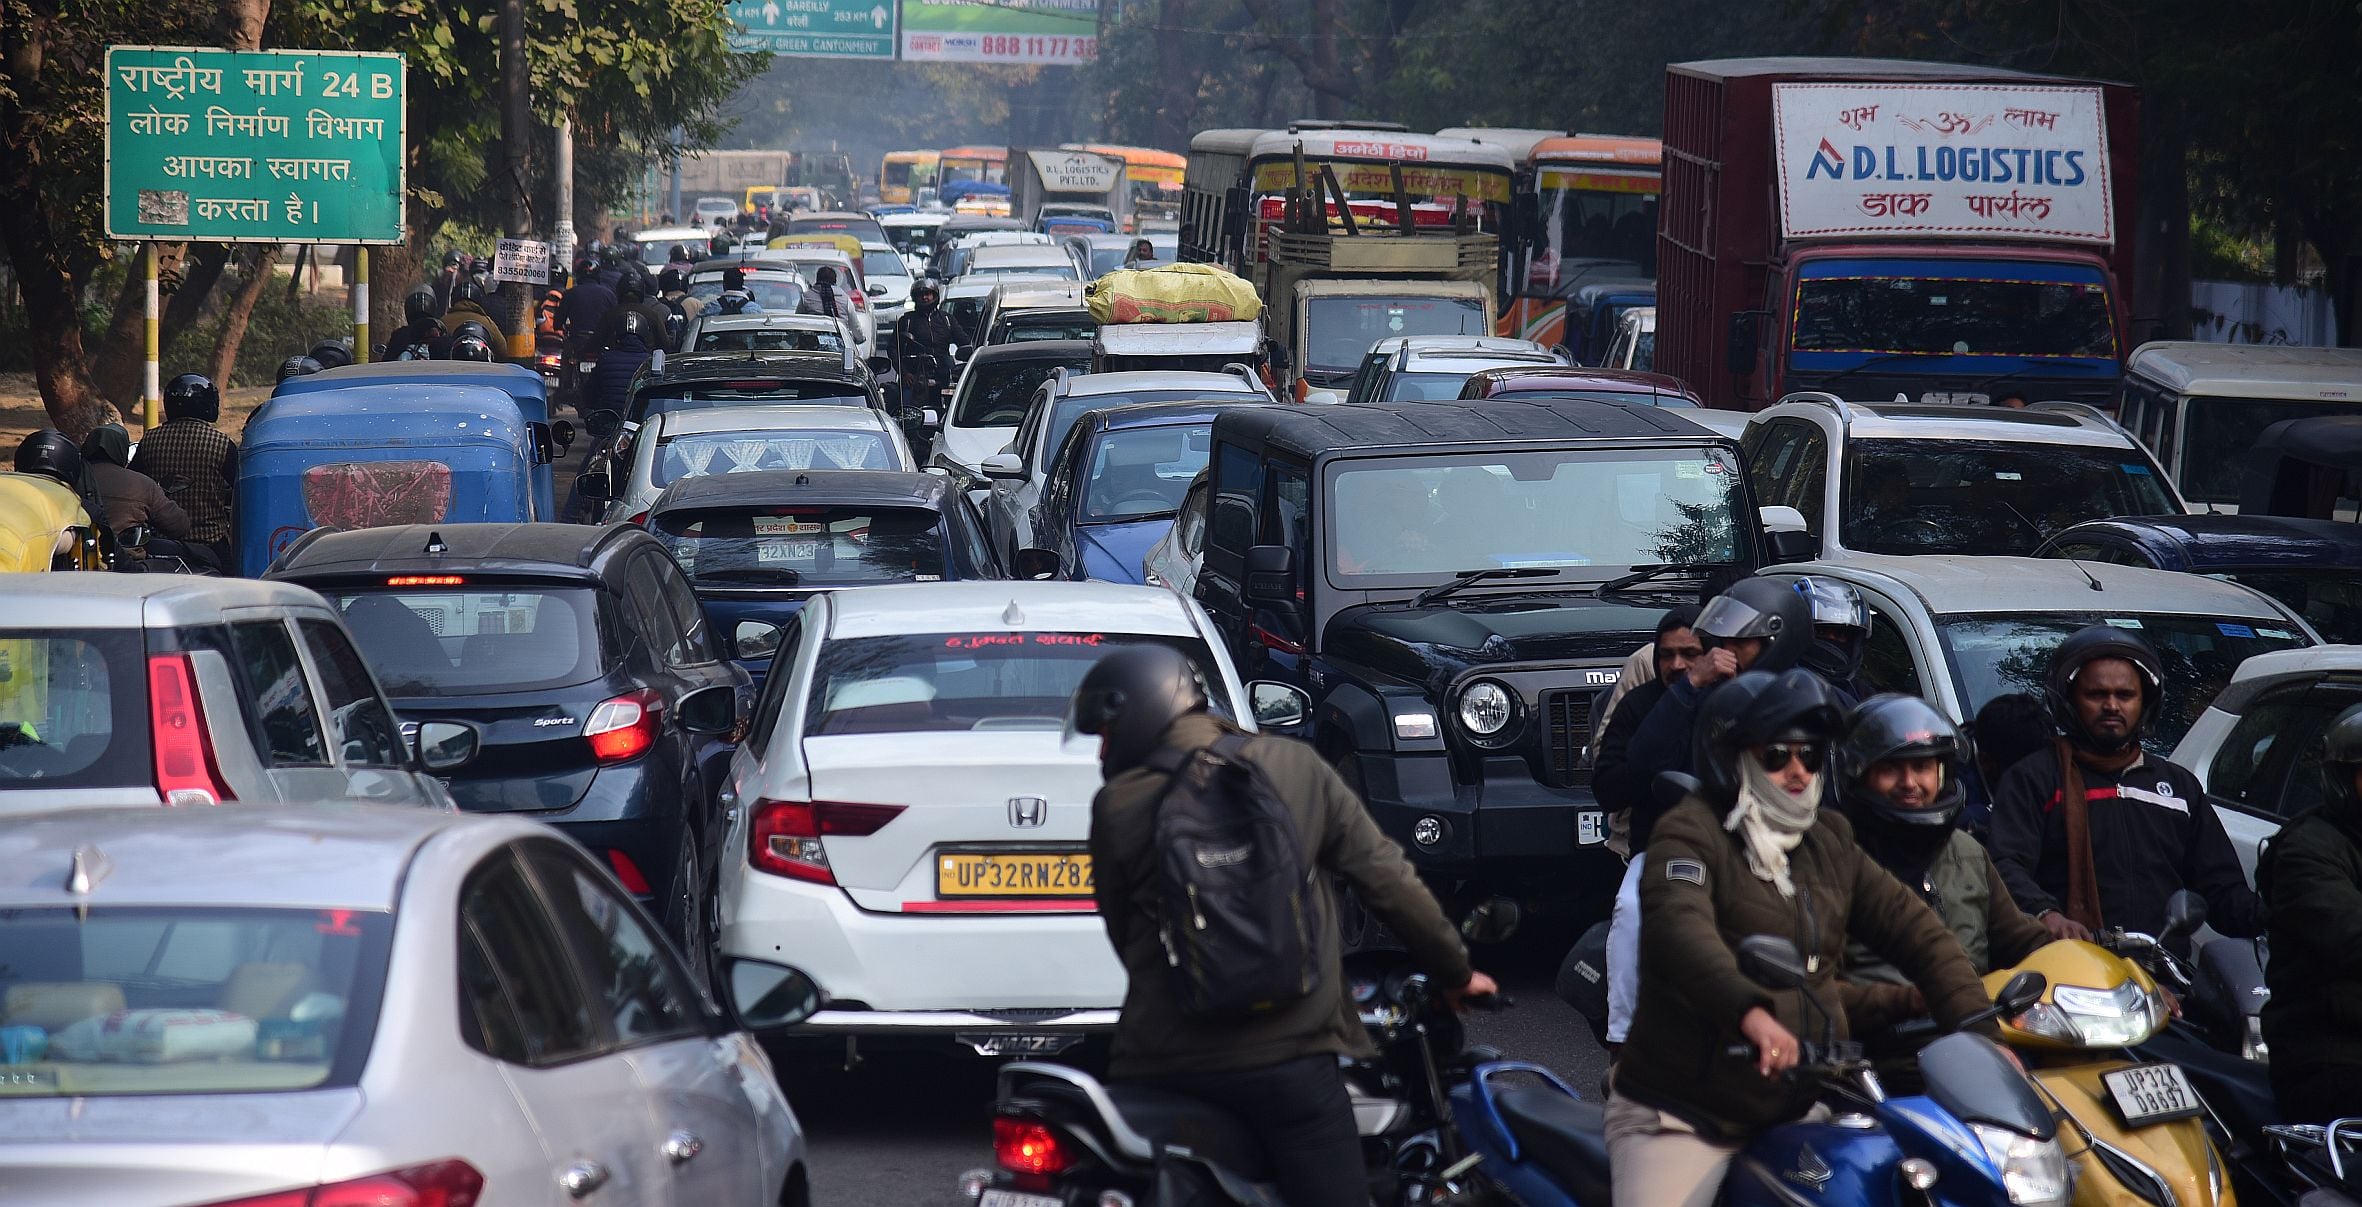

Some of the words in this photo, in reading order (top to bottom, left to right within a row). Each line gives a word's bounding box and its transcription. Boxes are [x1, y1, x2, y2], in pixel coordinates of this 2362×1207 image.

[853, 12, 867, 22] KM
[776, 38, 807, 50] GREEN
[813, 39, 879, 52] CANTONMENT
[982, 36, 1020, 55] 888
[1027, 38, 1043, 56] 11
[1050, 39, 1068, 57] 77
[118, 56, 223, 100] राष्ट्रीय
[242, 61, 304, 96] मार्ग
[322, 72, 360, 98] 24
[371, 74, 393, 99] B
[128, 104, 190, 135] लोक
[205, 105, 290, 138] निर्माण
[305, 108, 384, 140] विभाग
[1839, 104, 1880, 131] शुभ
[2003, 107, 2061, 131] लाभ
[1336, 143, 1383, 156] अमेठी
[1389, 146, 1426, 160] डिपो
[163, 155, 252, 179] आपका
[266, 158, 351, 181] स्वागत
[1065, 165, 1109, 175] LOGISTICS
[196, 198, 269, 222] करता
[1860, 193, 1933, 218] डाक
[1964, 190, 2053, 221] पार्सल
[498, 267, 546, 278] 8355020060
[767, 524, 785, 532] प्रदेश
[762, 545, 814, 558] 32XN23
[534, 718, 574, 727] Sportz
[959, 863, 1095, 887] UP32RN282
[983, 1036, 1059, 1050] AMAZE
